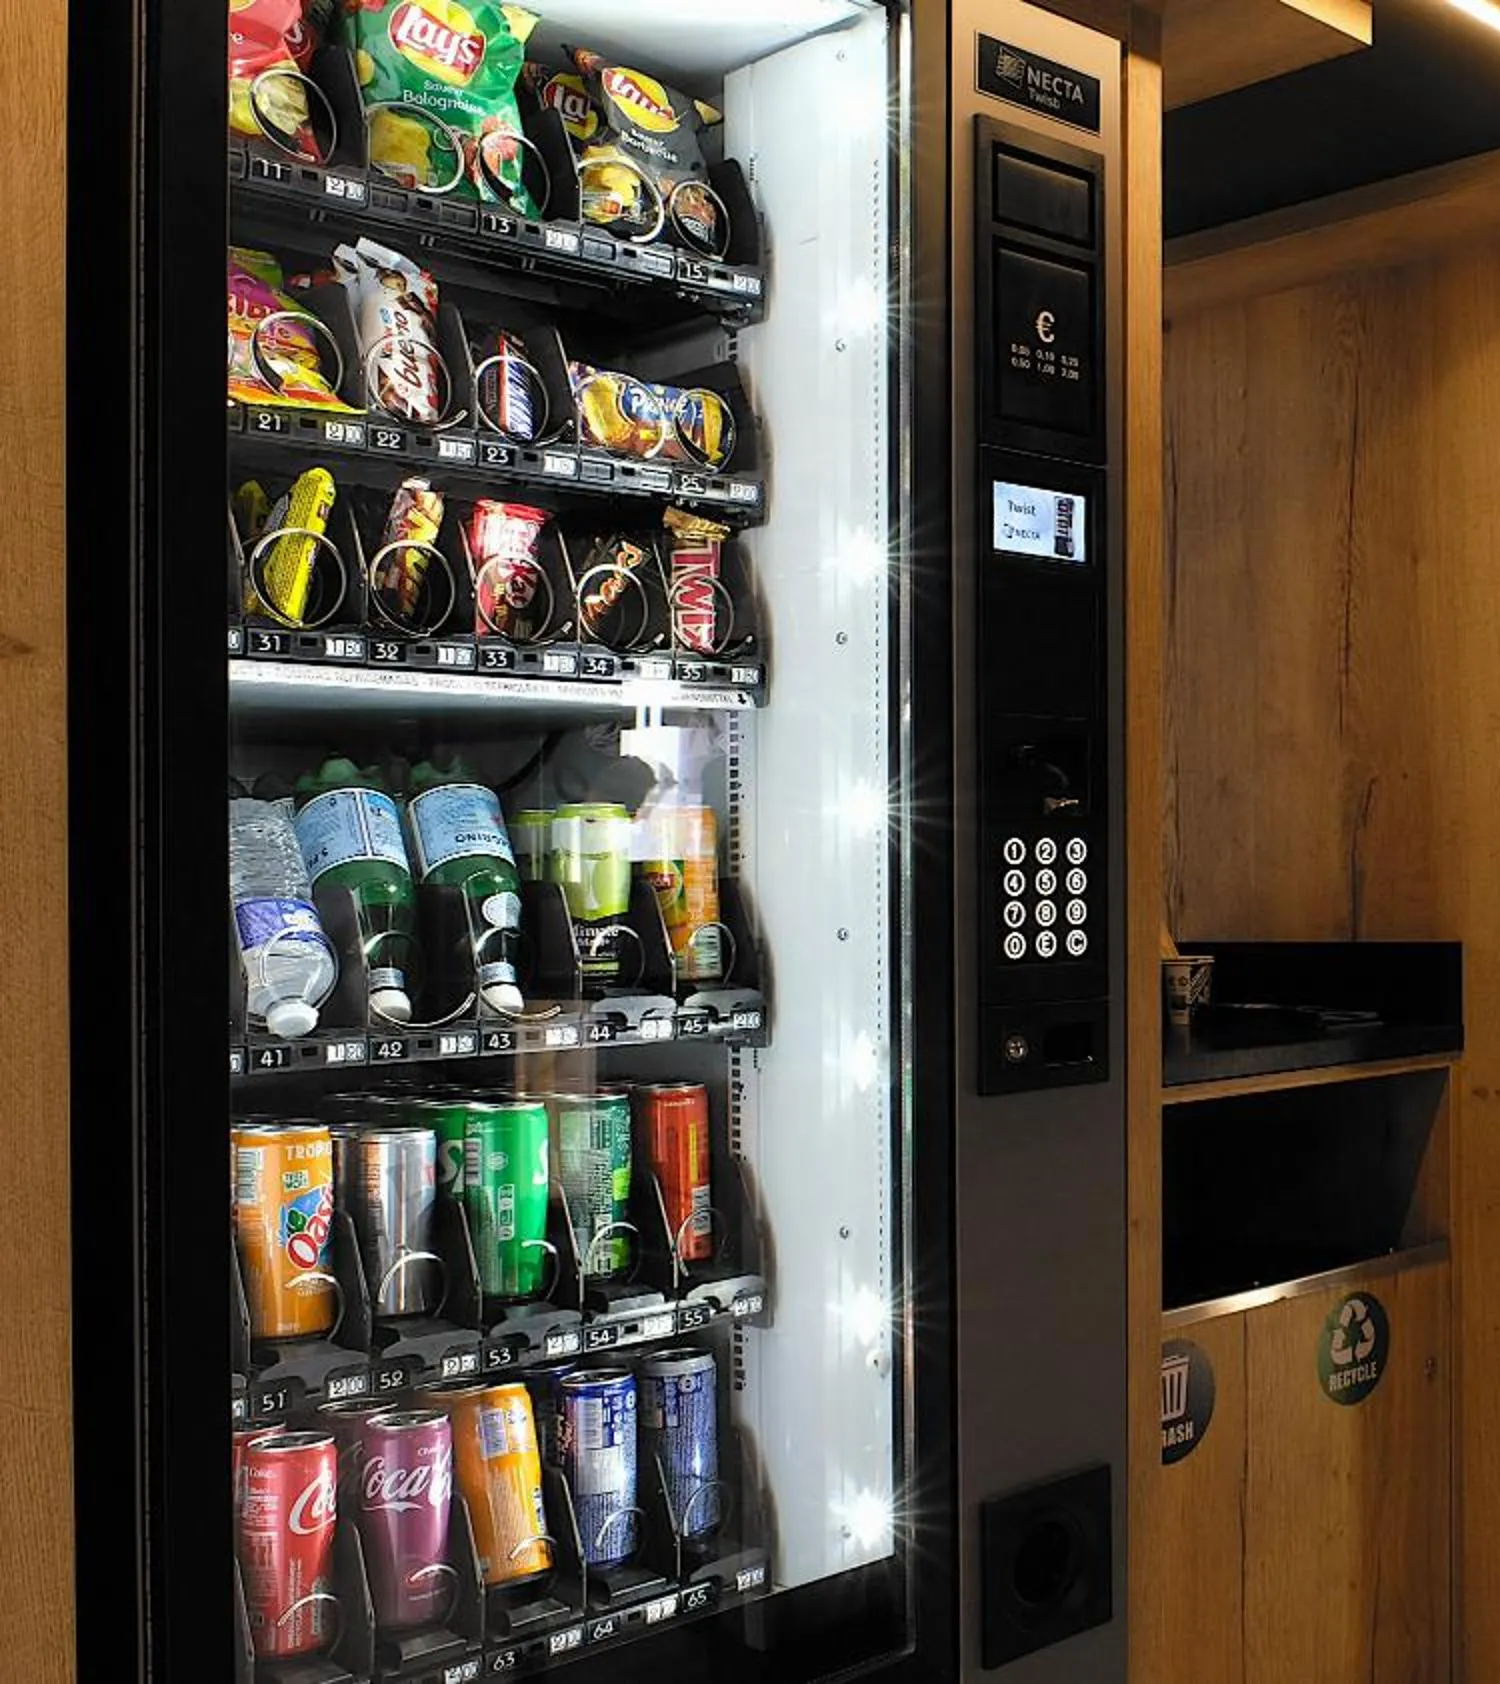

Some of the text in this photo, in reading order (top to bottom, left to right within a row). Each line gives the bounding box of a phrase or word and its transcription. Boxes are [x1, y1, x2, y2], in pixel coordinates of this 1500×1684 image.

[1027, 65, 1084, 105] NECTA
[489, 213, 511, 233] 13
[685, 263, 703, 278] 15
[1035, 311, 1055, 343] €
[258, 413, 281, 431] 21
[377, 431, 400, 448] 22
[487, 446, 509, 463] 23
[681, 474, 700, 491] 25
[258, 634, 281, 652] 31
[375, 642, 399, 660] 32
[486, 650, 507, 667] 33
[586, 657, 607, 676] 34
[681, 664, 701, 680] 35
[590, 1025, 611, 1042] 44
[683, 1018, 702, 1034] 45
[378, 1041, 402, 1059] 42
[488, 1032, 511, 1050] 43
[260, 1049, 284, 1067] 41
[685, 1309, 703, 1325] 55
[590, 1329, 611, 1347] 54
[489, 1347, 511, 1367] 53
[379, 1371, 403, 1389] 52
[1328, 1361, 1378, 1393] RECYCLE
[261, 1392, 285, 1413] 51
[687, 1588, 708, 1608] 65
[593, 1619, 613, 1639] 64
[493, 1650, 515, 1672] 63
